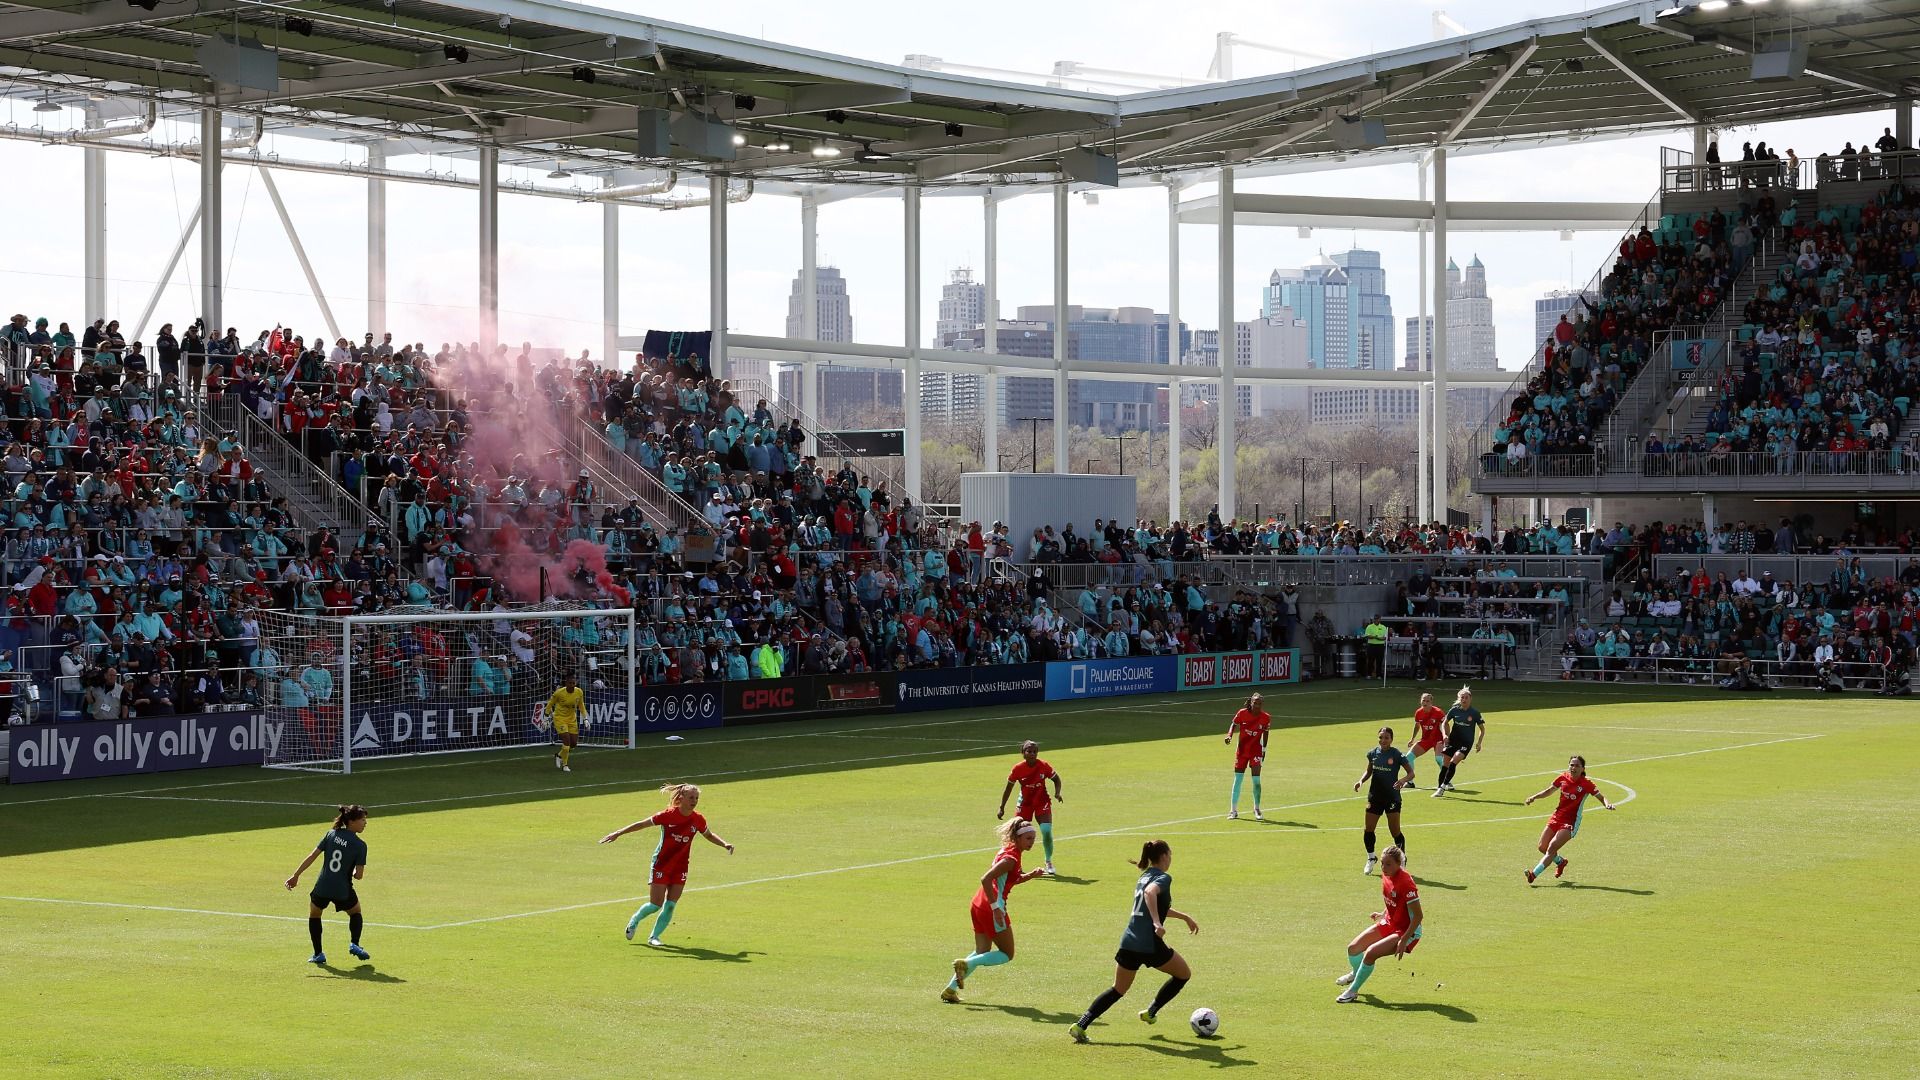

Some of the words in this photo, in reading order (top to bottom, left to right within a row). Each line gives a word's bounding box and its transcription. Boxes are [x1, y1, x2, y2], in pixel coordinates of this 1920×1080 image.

[1090, 668, 1122, 683] PALMER
[1122, 666, 1154, 681] SQUARE
[1192, 660, 1215, 683] BABY
[1229, 658, 1252, 680] BABY
[1267, 655, 1290, 678] BABY
[742, 687, 795, 710] CPKC
[908, 687, 922, 698] THE
[922, 685, 960, 697] UNIVERSITY
[960, 684, 970, 694] OF
[972, 682, 996, 694] KANSAS
[997, 681, 1020, 692] HEALTH
[1020, 679, 1043, 690] SYSTEM
[1090, 686, 1112, 694] CAPITAL
[1114, 683, 1152, 692] MANAGEMENT
[229, 714, 285, 757] ally
[392, 705, 508, 743] DELTA
[17, 728, 81, 775] ally
[93, 723, 153, 769] ally
[158, 718, 217, 763] ally
[329, 849, 343, 873] 8
